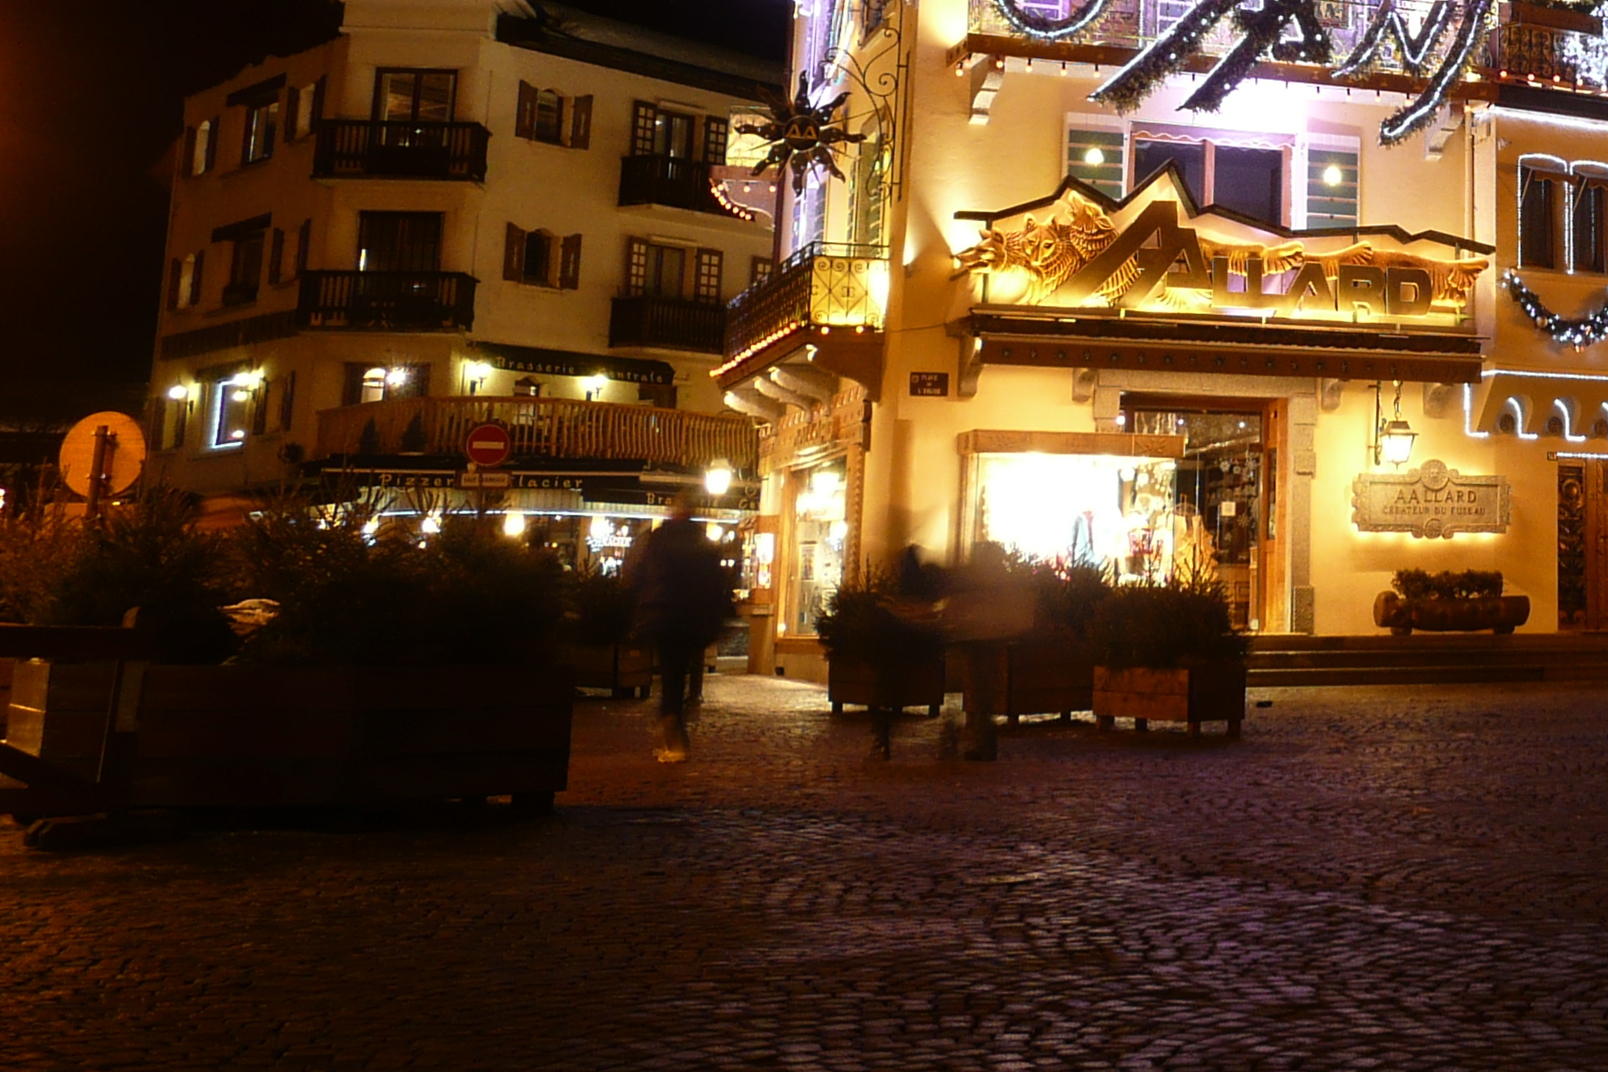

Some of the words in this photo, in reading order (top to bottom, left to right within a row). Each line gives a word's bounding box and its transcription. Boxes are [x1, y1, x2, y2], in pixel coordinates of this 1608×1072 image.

[495, 356, 575, 374] Brasserie
[512, 477, 583, 489] lacier
[1394, 489, 1477, 504] AALLARD
[1434, 505, 1447, 515] DU
[1450, 506, 1486, 516] FUSEAU
